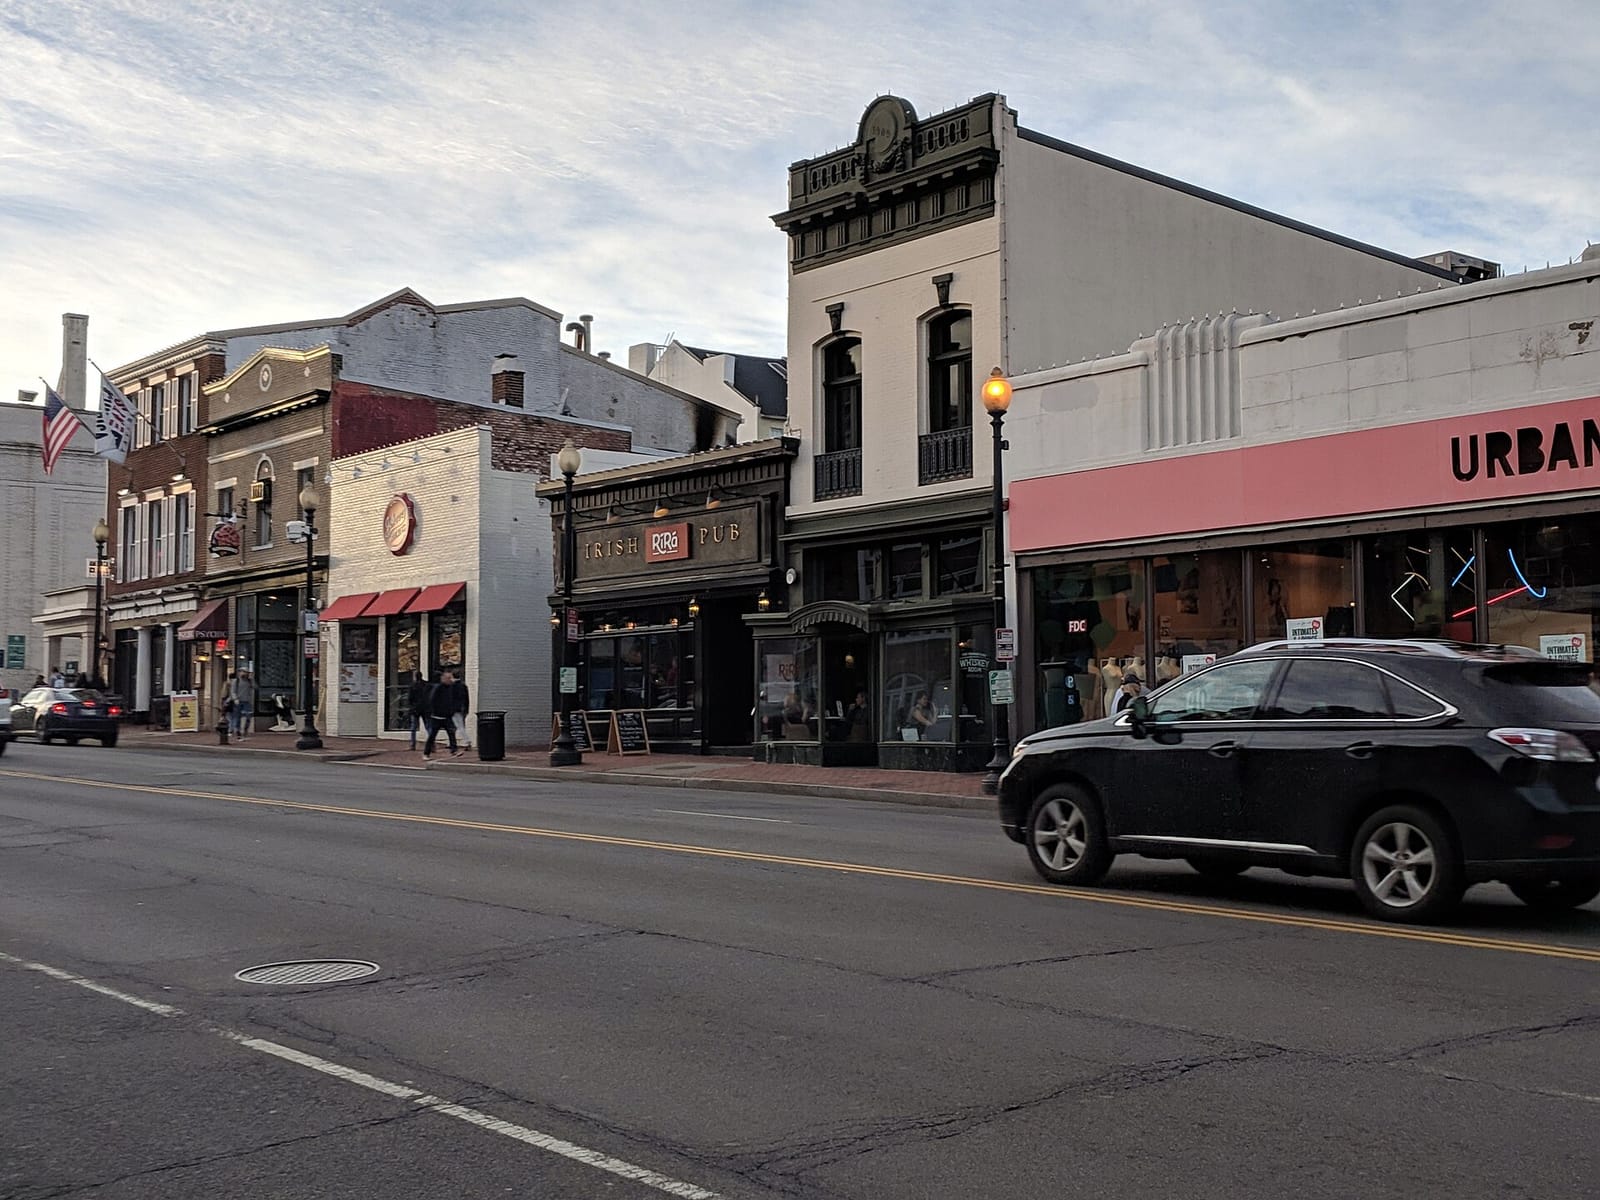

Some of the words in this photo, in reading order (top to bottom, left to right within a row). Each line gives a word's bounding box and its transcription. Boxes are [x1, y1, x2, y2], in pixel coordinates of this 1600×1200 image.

[1451, 419, 1600, 482] URBAN
[584, 537, 639, 559] IRISH
[700, 523, 740, 545] PUB
[1291, 628, 1318, 636] INTIMATES
[1546, 645, 1579, 655] INTIMATES
[960, 658, 990, 668] WHISKEY
